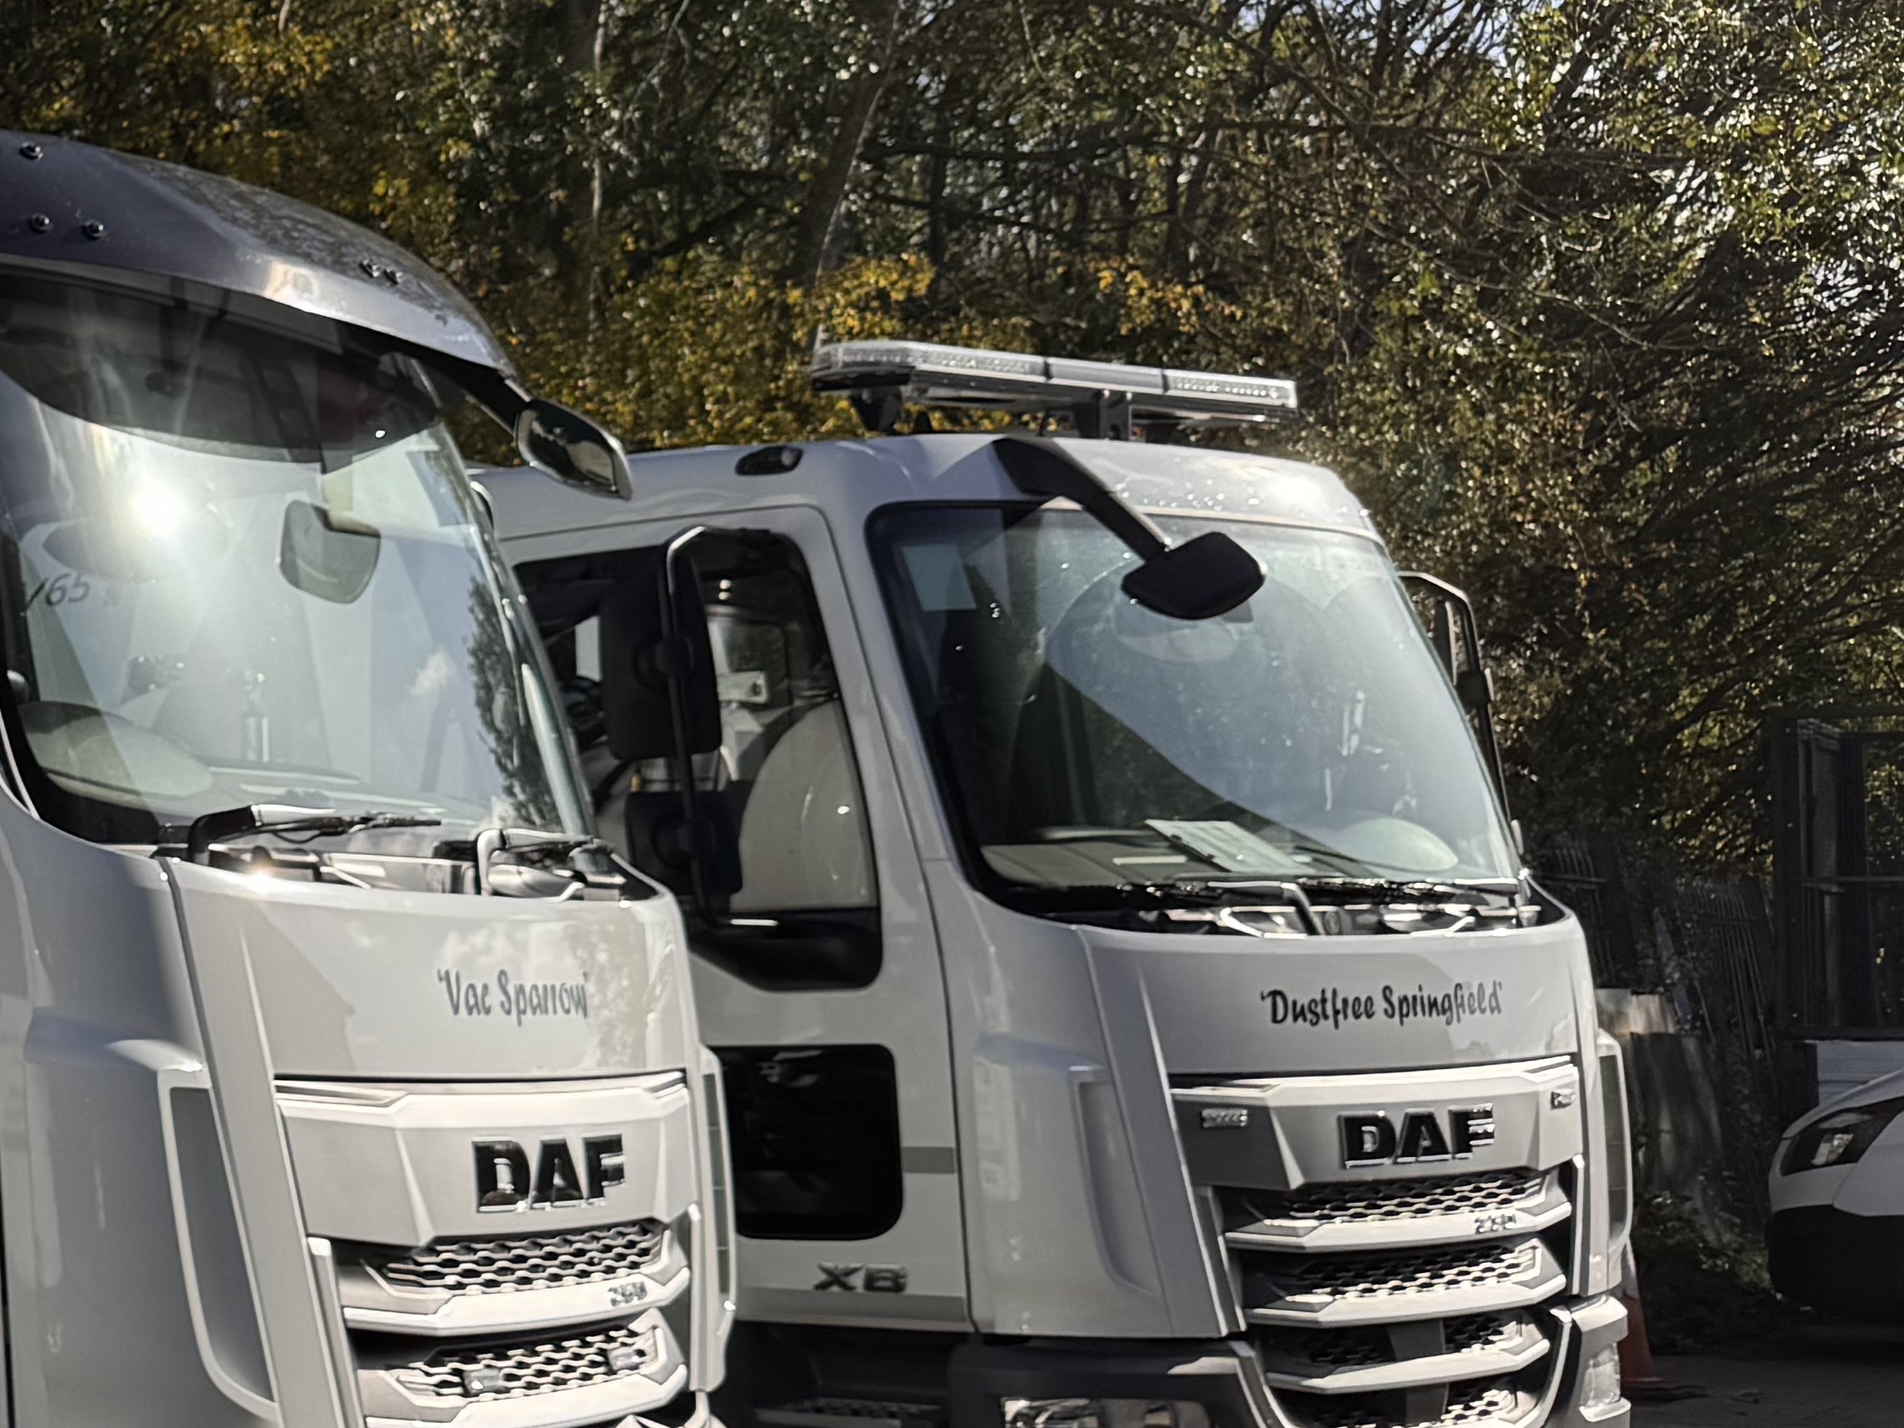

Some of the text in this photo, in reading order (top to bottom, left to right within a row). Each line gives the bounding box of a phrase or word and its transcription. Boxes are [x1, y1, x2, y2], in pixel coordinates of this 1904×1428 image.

[1337, 1103, 1495, 1169] DAF
[471, 1134, 625, 1213] DAF
[813, 1262, 908, 1293] XB
